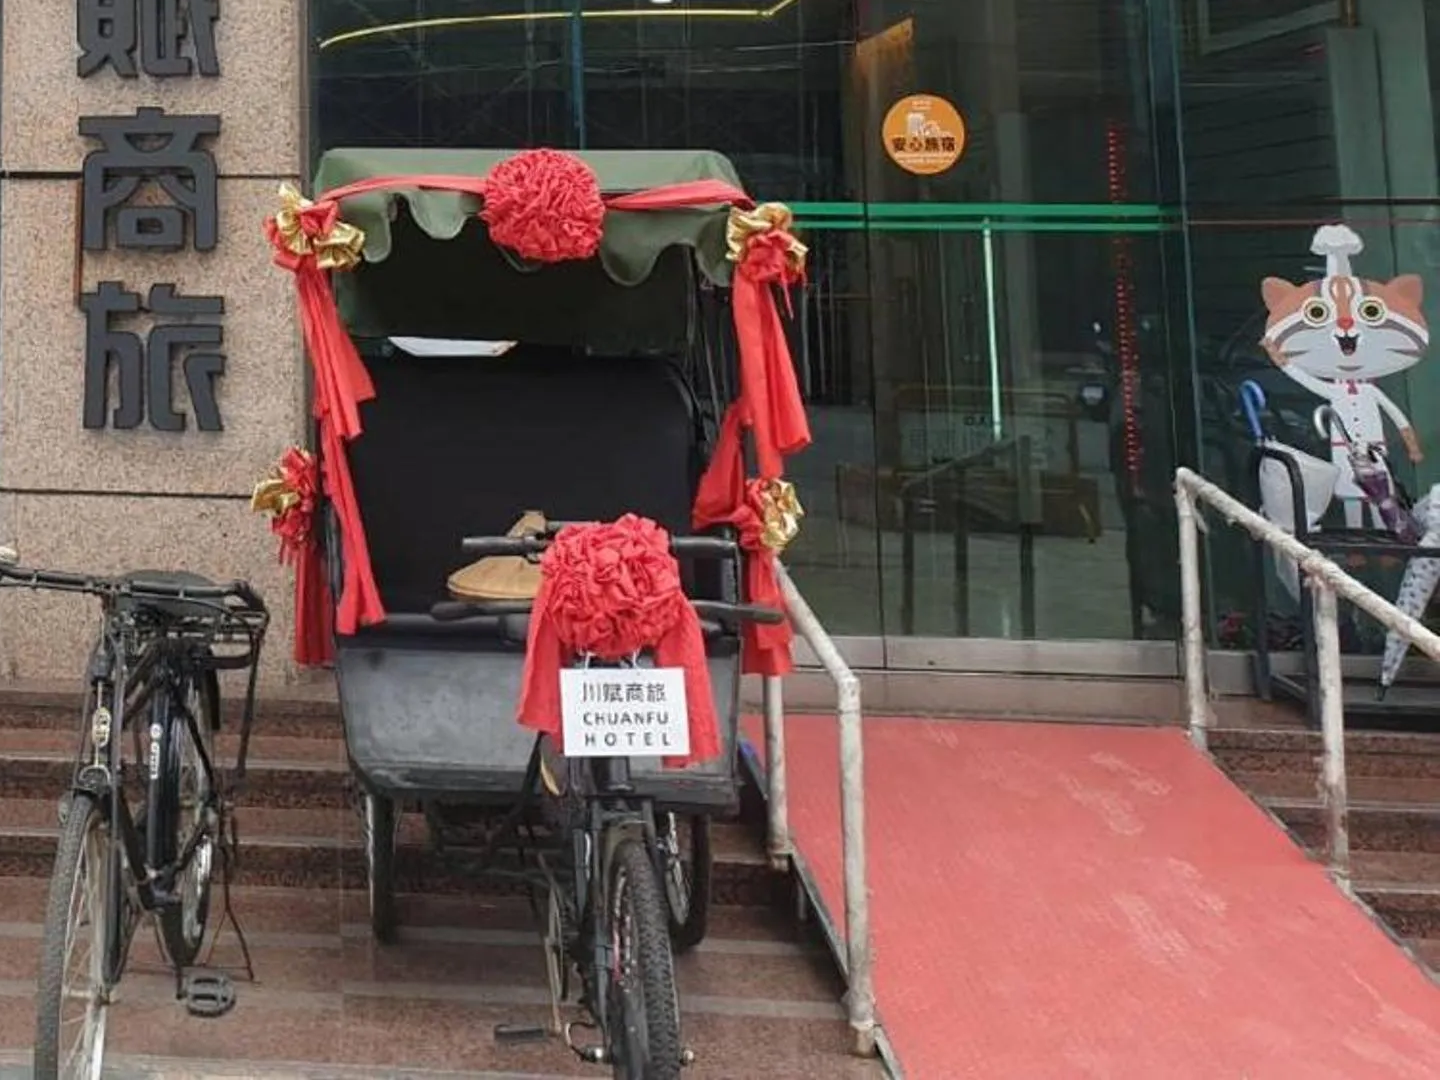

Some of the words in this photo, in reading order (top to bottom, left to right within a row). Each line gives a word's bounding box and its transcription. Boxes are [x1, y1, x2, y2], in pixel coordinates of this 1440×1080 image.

[891, 135, 956, 153] 安心旅宿
[583, 711, 669, 726] CHUANFU
[585, 731, 671, 747] HOTEL
